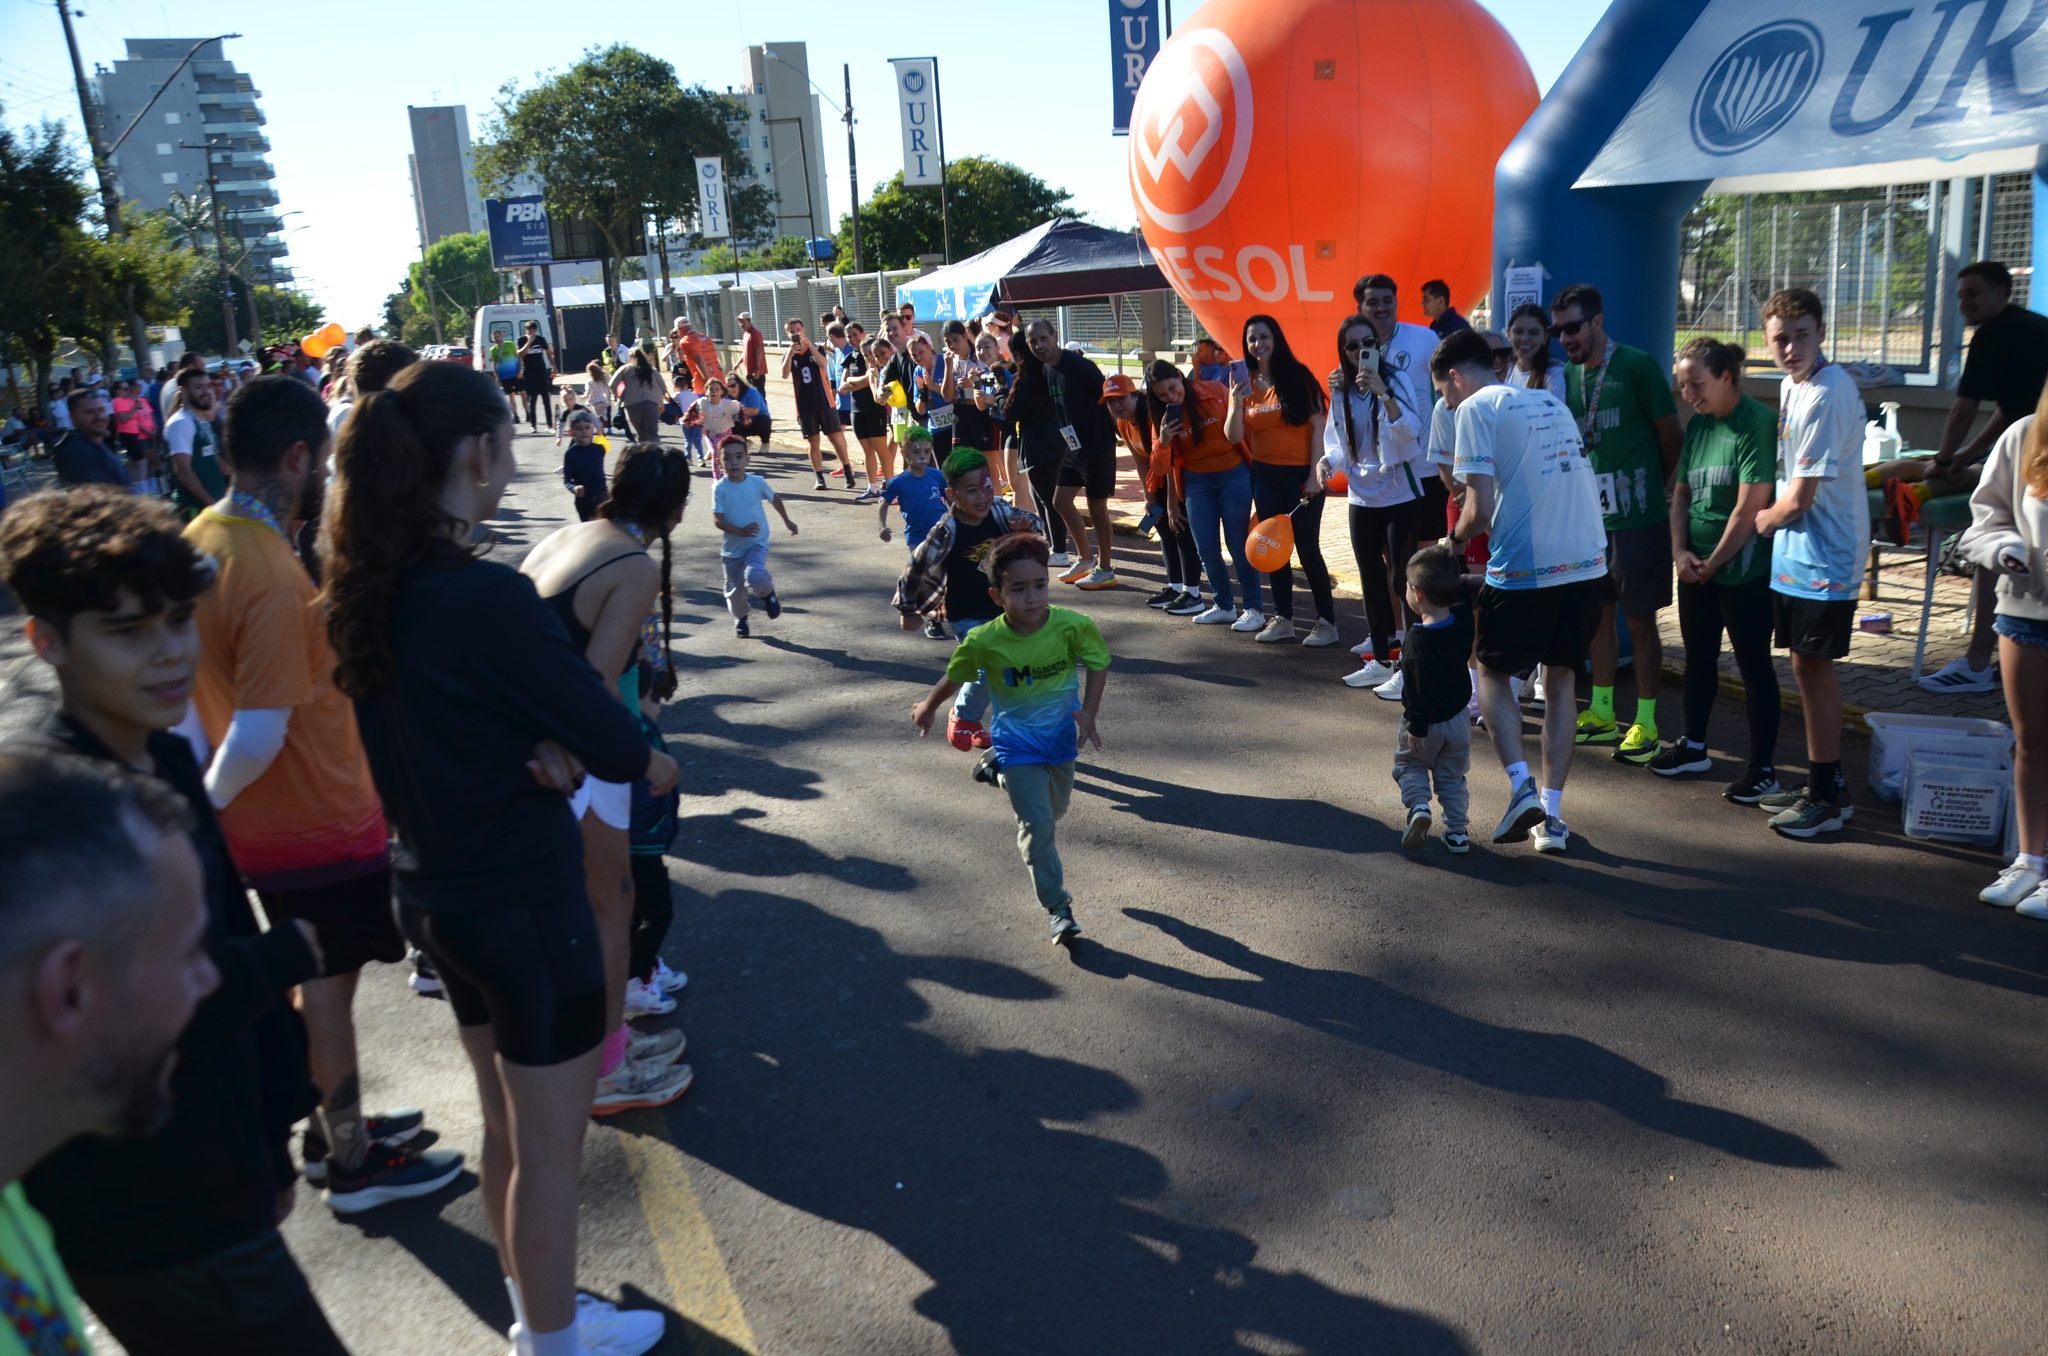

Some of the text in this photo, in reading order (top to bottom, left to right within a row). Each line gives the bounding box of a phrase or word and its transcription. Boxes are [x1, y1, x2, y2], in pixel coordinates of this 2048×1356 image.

[1121, 16, 1149, 97] UR
[906, 102, 930, 178] URI
[704, 183, 720, 232] URI
[801, 366, 812, 384] 9
[1254, 402, 1282, 414] CRESO
